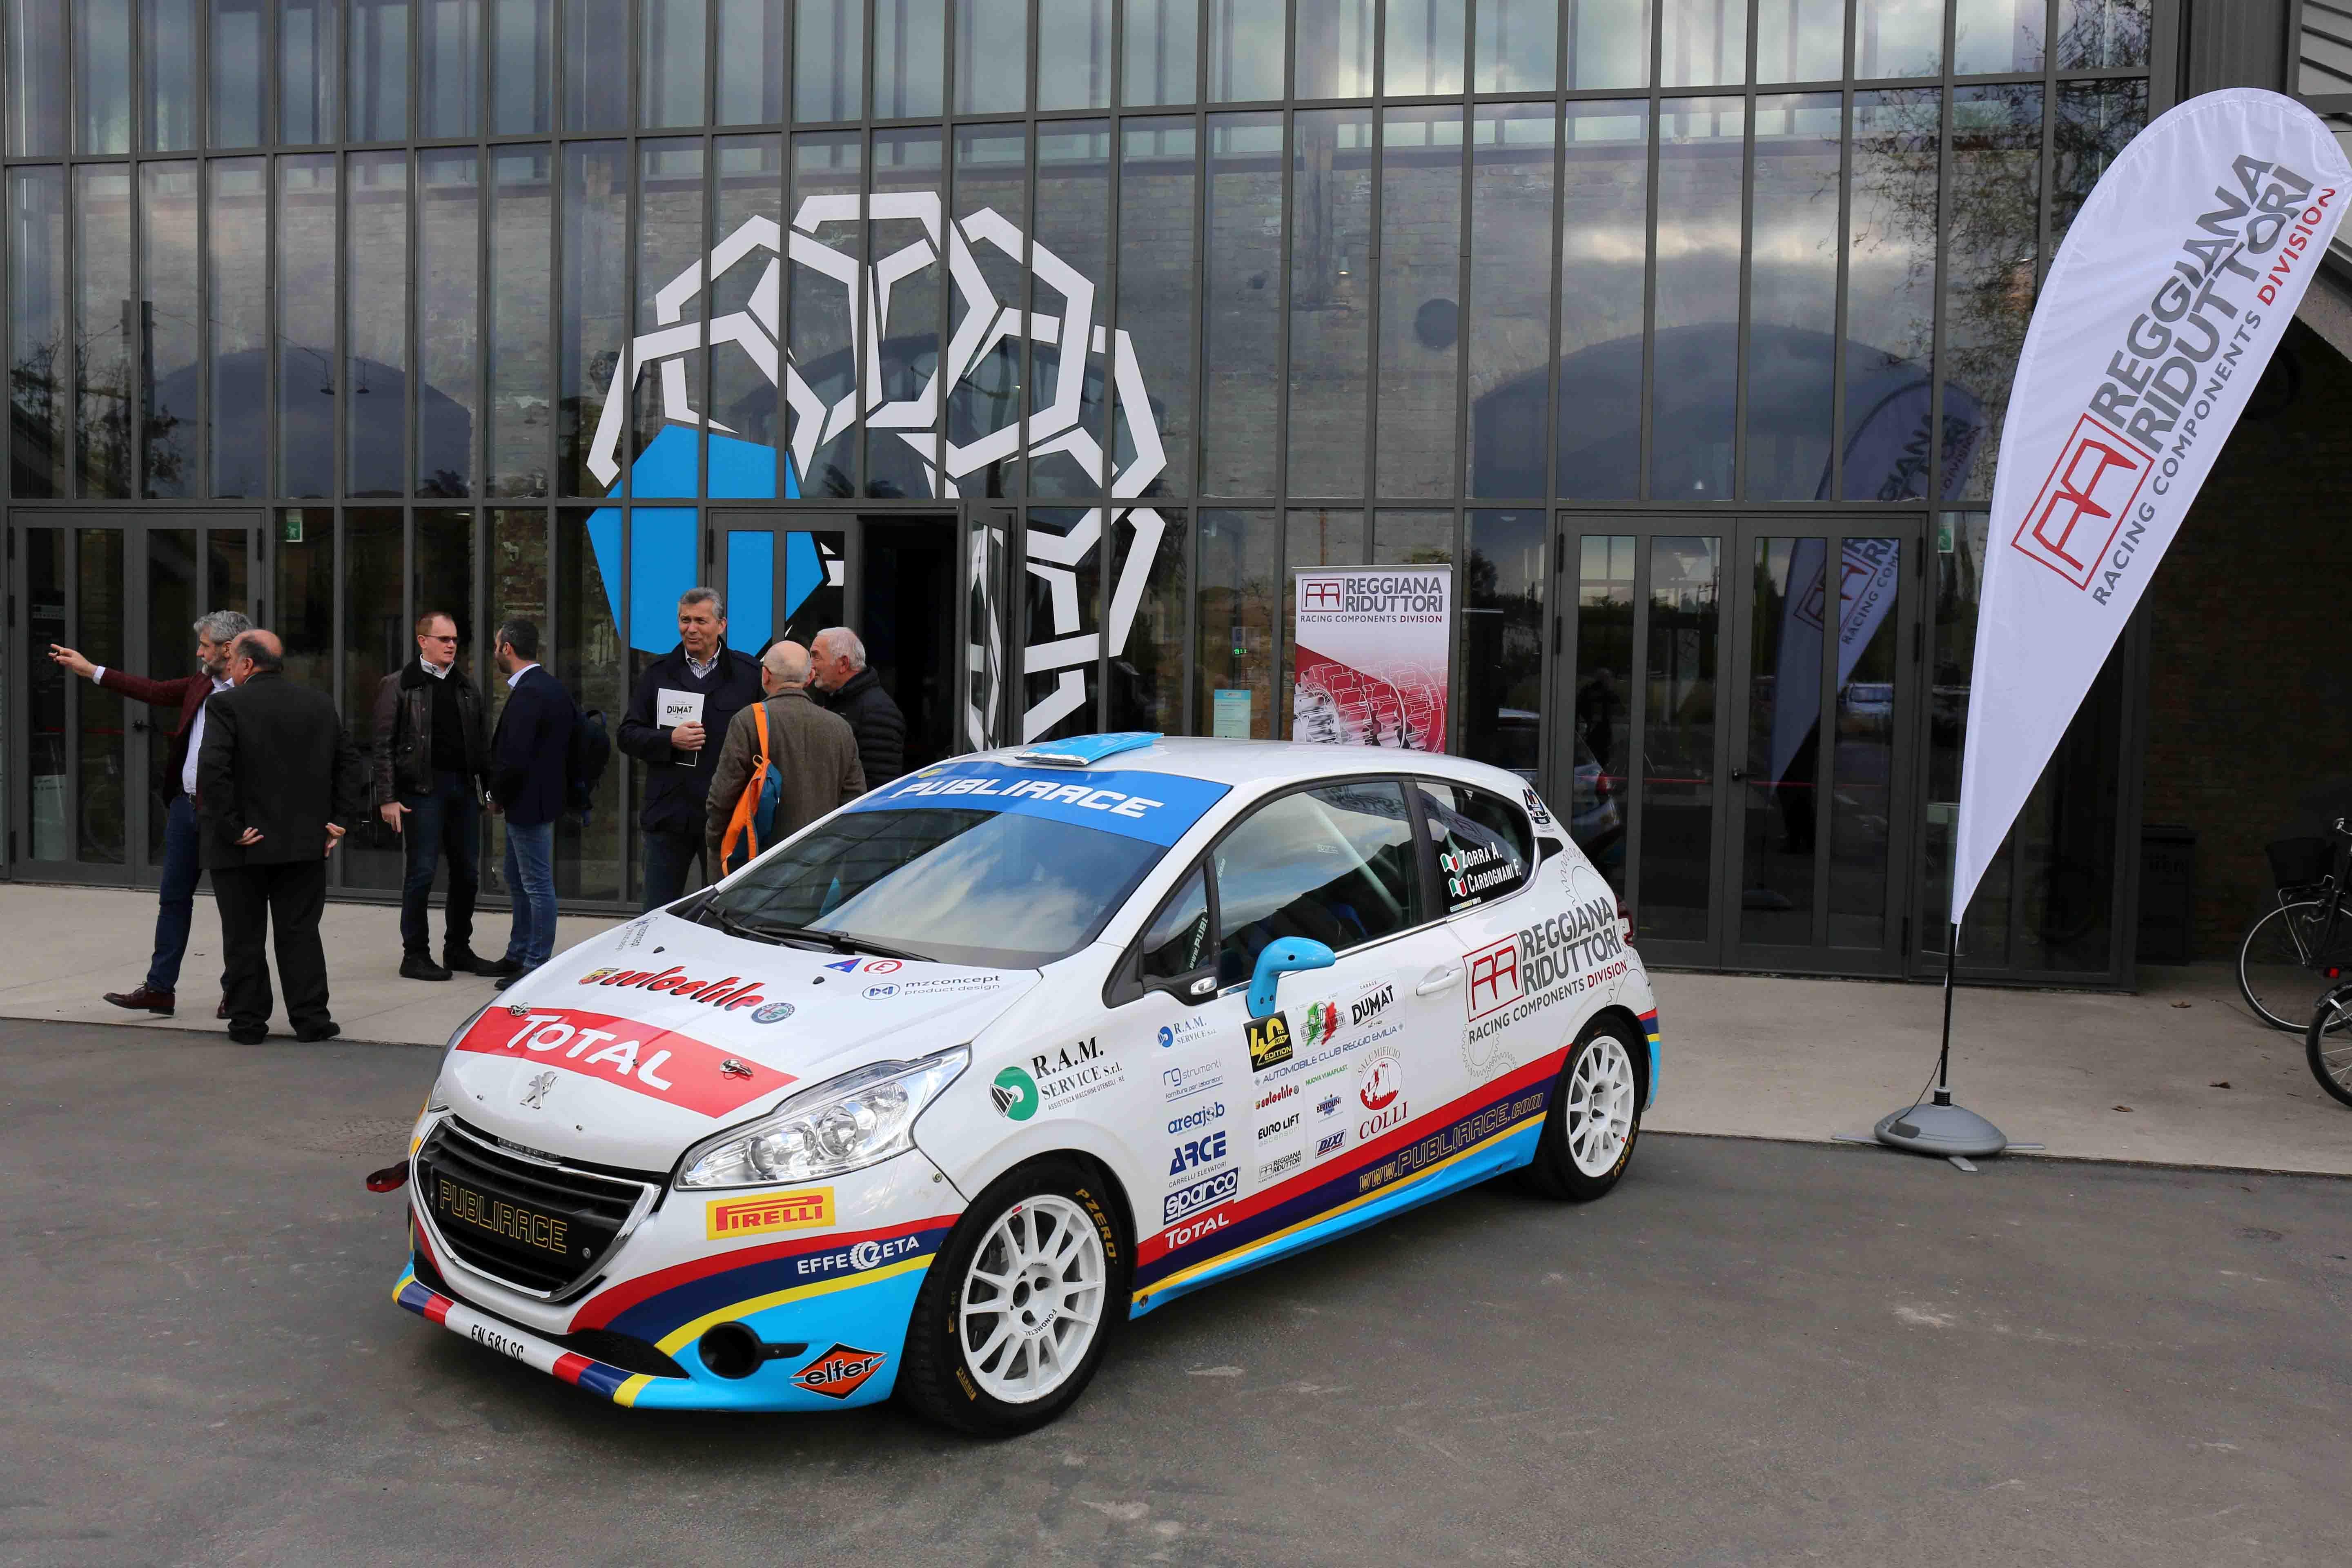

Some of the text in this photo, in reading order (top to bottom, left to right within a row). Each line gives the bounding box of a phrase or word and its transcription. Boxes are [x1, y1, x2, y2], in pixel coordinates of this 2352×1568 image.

[2088, 155, 2274, 429] REGGIANA
[2125, 166, 2314, 454] RIDUTTORI
[2092, 188, 2335, 606] RACING COMPONENTS DIVISION
[1346, 577, 1442, 595] REGGIANA
[1346, 595, 1442, 612] RIDUTTORI
[667, 706, 693, 714] DUMAT
[888, 778, 1165, 818] PUBLIRACE
[1491, 842, 1503, 860] A.
[1513, 858, 1522, 877] F.
[1519, 897, 1615, 962] REGGIANA
[1522, 926, 1622, 996] RIDUTTORI
[904, 983, 1000, 995] product design
[905, 975, 1000, 987] mzconcept
[1352, 984, 1394, 1025] DUMAT
[1469, 960, 1628, 1045] RACING COMPONENTS DIVISION
[1174, 1016, 1207, 1034] R.A.M.
[1176, 1029, 1206, 1045] SERVICE
[507, 1015, 673, 1091] TOTAL
[1031, 1036, 1104, 1080] R.A.M.
[1263, 1056, 1317, 1084] AUTOMOBILE
[1319, 1047, 1341, 1062] CLUB
[1343, 1036, 1371, 1052] REGGIO
[1372, 1026, 1397, 1041] EMILIA
[1264, 1045, 1292, 1061] EDITION
[1358, 1046, 1401, 1076] SALUMIFICIO
[1041, 1065, 1102, 1100] SERVICE
[1048, 1095, 1075, 1111] ASSISTENZA
[1075, 1087, 1097, 1100] MACCHINE
[1097, 1079, 1116, 1091] UTENSILI
[1168, 1101, 1225, 1134] areajob
[1258, 1121, 1281, 1140] EURO
[1283, 1113, 1300, 1129] LIFT
[1359, 1100, 1408, 1139] COLLI
[1169, 1130, 1226, 1176] ARCE
[1273, 1156, 1301, 1173] RIDUTTORI
[1274, 1150, 1301, 1167] REGGIANA
[1169, 1161, 1227, 1188] CARRELLI ELEVATORI
[1166, 1172, 1236, 1217] sparco
[439, 1179, 568, 1254] PUBLIRACE
[716, 1195, 824, 1231] PIRELLI
[1165, 1213, 1229, 1249] TOTAL
[1025, 1308, 1057, 1336] FONDMETAL
[804, 1357, 874, 1386] elfer
